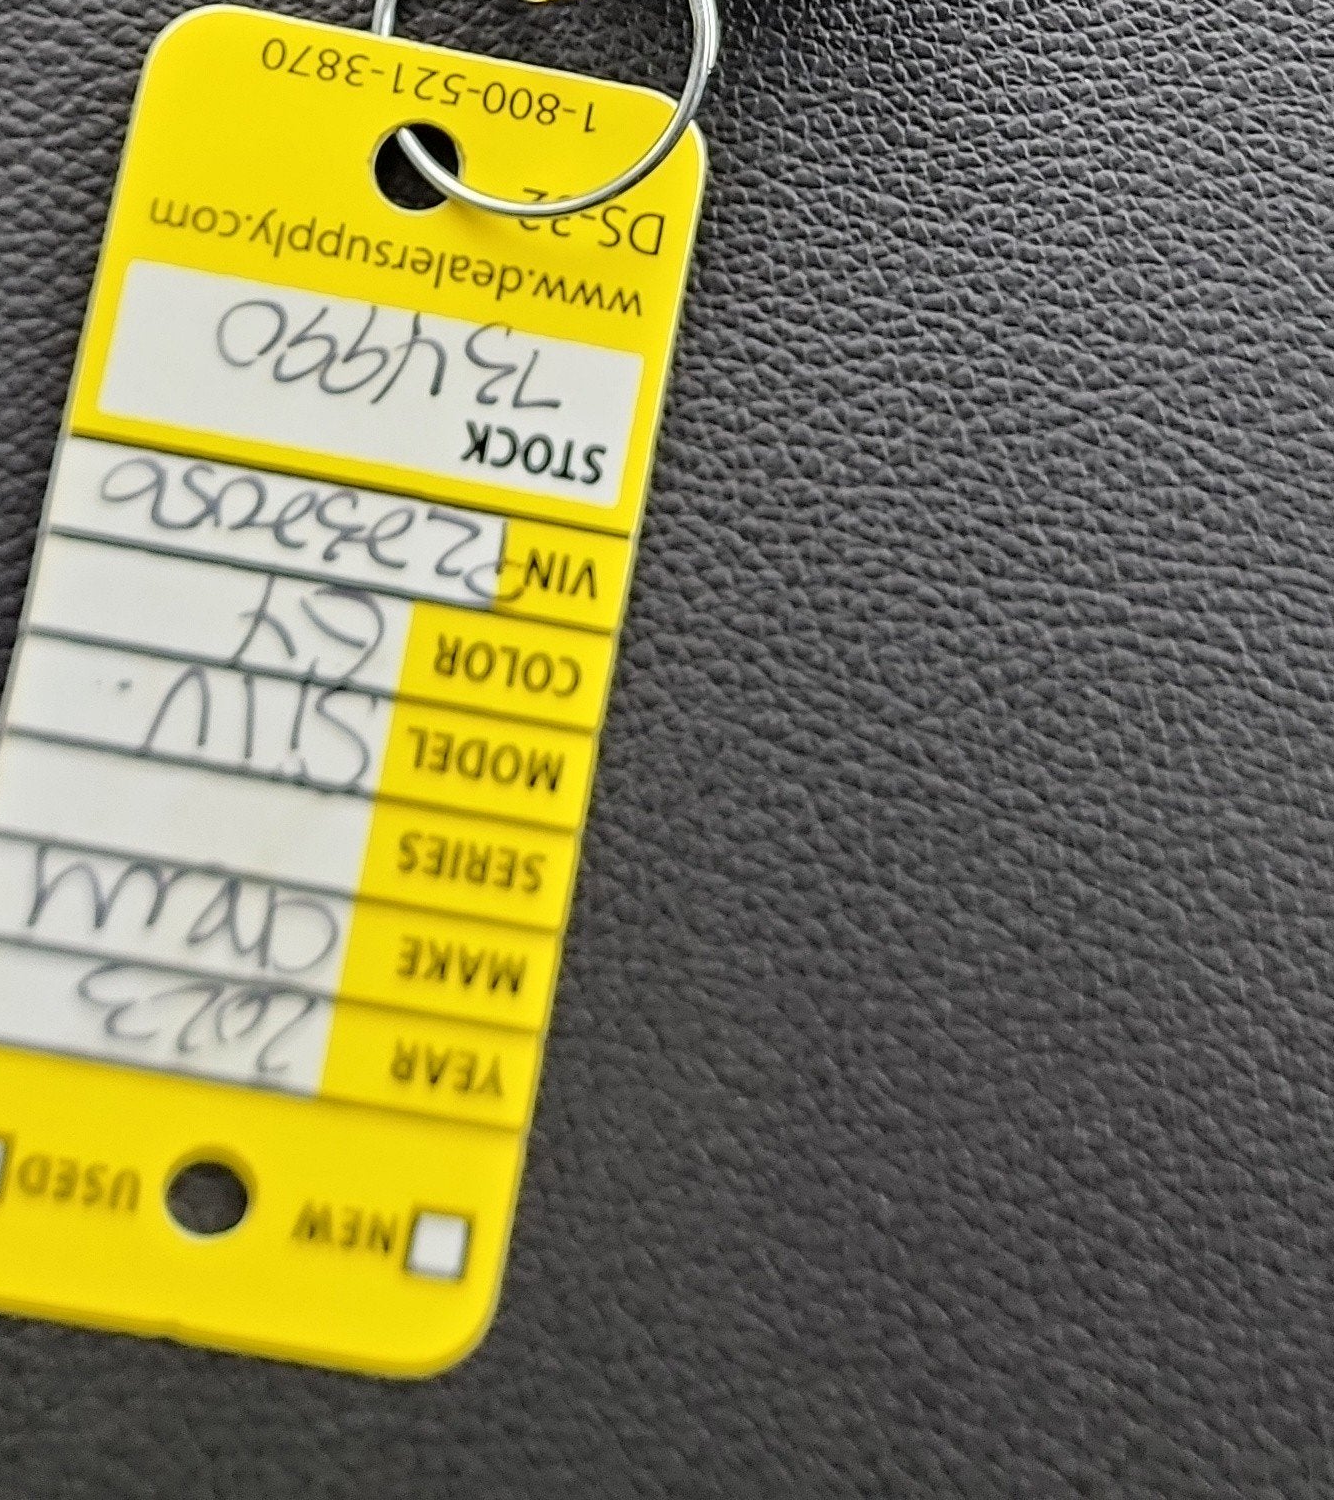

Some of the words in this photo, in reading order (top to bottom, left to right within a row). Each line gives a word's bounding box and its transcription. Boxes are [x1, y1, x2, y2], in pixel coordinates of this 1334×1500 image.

[261, 37, 597, 134] 1-800-521-3870
[148, 197, 643, 317] www.dealersupply.com
[216, 299, 562, 410] 734990
[462, 420, 608, 485] STOCK
[522, 547, 598, 599] VIN
[435, 633, 583, 698] COLOR
[409, 726, 566, 794] MODEL
[396, 831, 547, 895] SERIES
[396, 935, 528, 997] MAKE
[76, 960, 329, 1078] 2023
[389, 1037, 507, 1099] YEAR
[17, 1152, 144, 1217] USED
[291, 1199, 400, 1256] NEW
